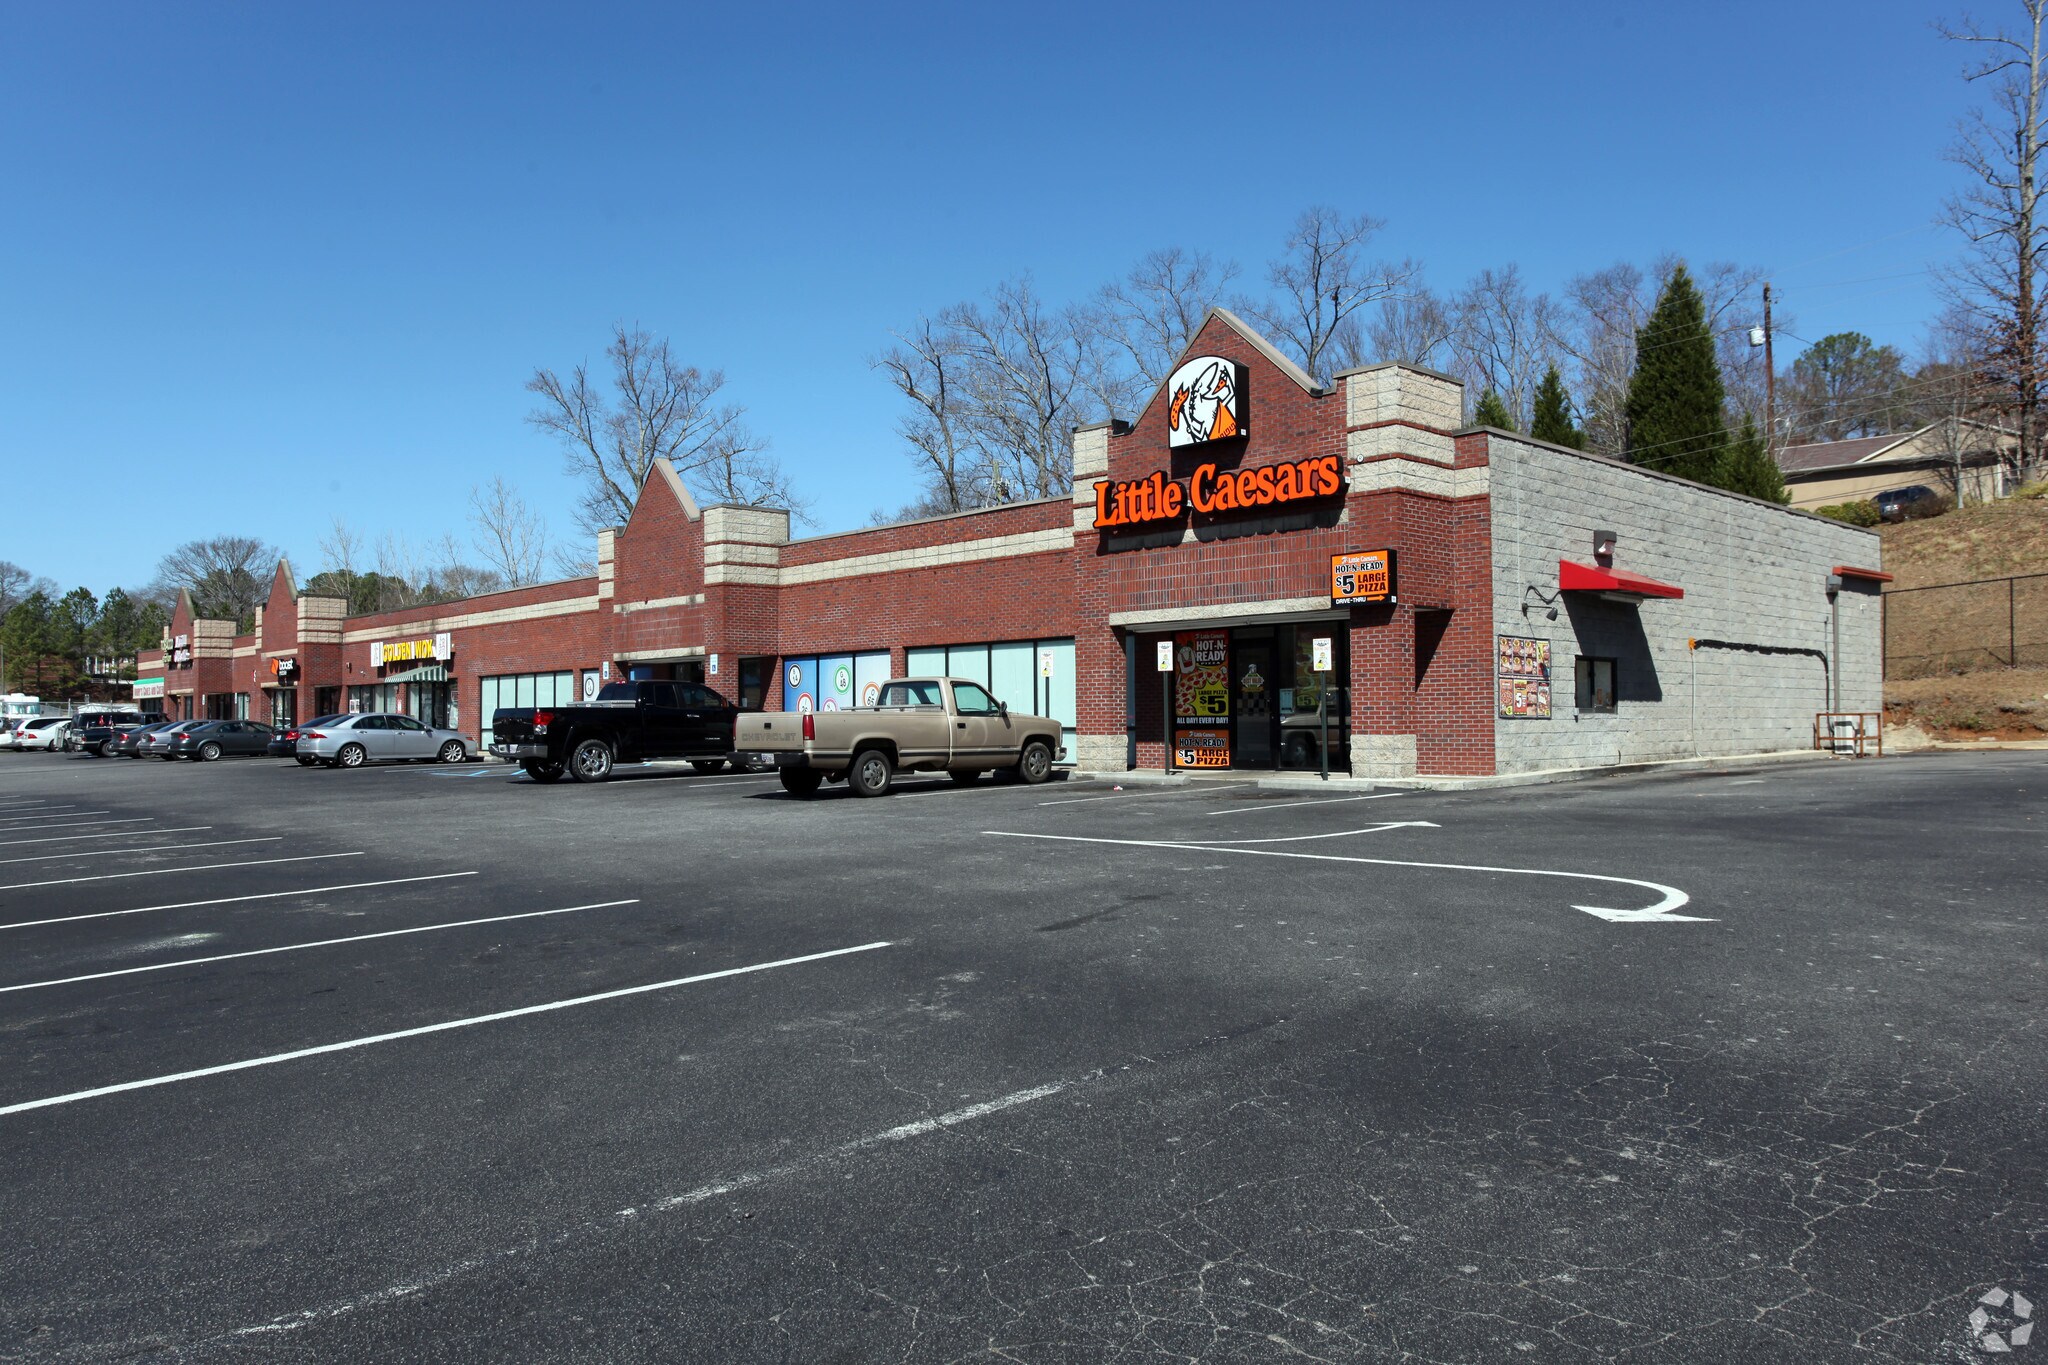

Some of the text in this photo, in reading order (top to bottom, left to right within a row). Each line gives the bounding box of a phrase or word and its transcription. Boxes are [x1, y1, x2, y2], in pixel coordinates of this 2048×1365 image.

[1093, 455, 1340, 528] Little Caesars
[1358, 572, 1386, 583] LARGE
[1336, 574, 1355, 594] $5
[1358, 582, 1386, 593] PIZZA
[383, 641, 411, 662] GOLDEN
[415, 638, 433, 659] WOK
[1196, 640, 1227, 651] HOT-N-
[1196, 650, 1226, 662] READY
[278, 658, 294, 670] boost
[840, 678, 846, 688] 48
[1200, 696, 1226, 714] $5
[742, 732, 796, 742] CHEVROLET
[1178, 749, 1195, 765] $5
[1196, 757, 1228, 765] PIZZA
